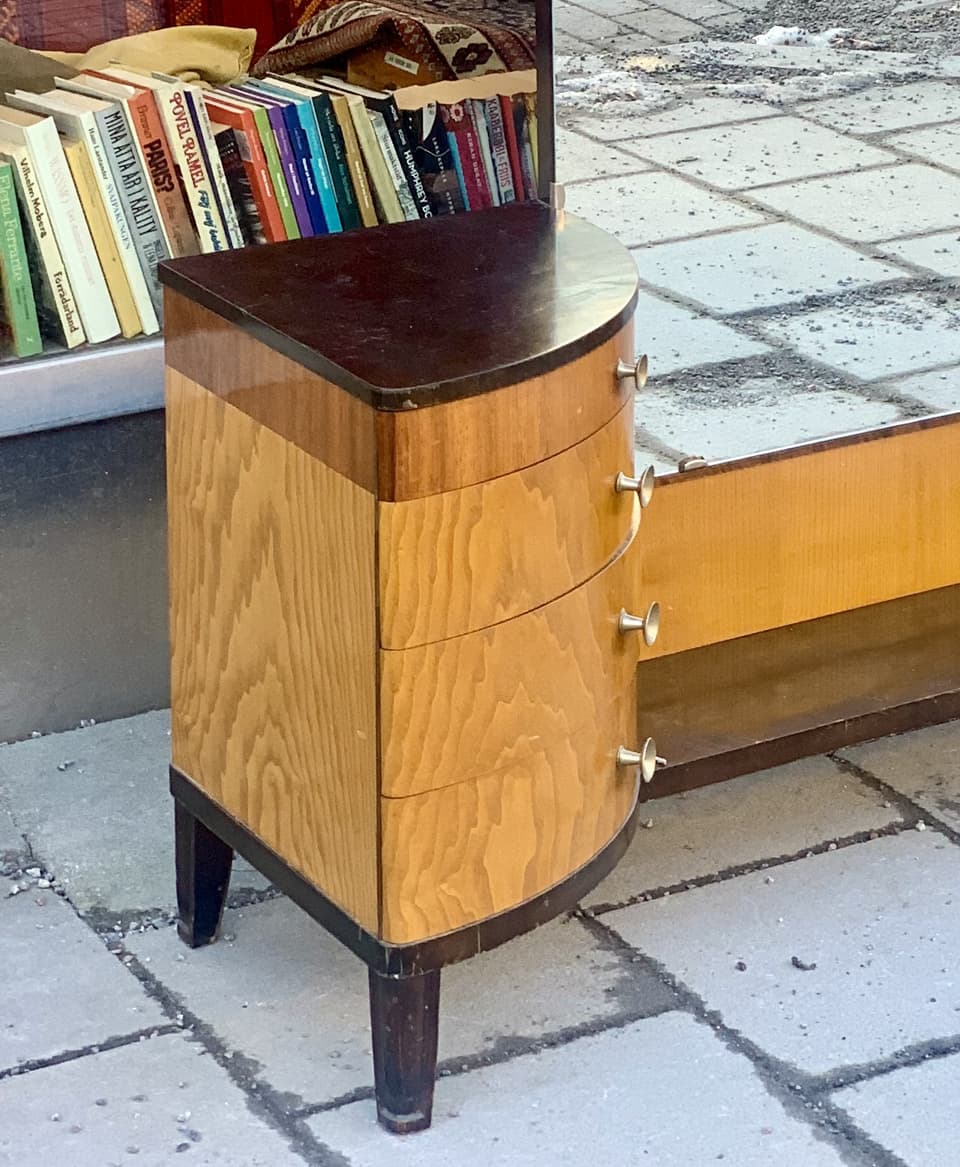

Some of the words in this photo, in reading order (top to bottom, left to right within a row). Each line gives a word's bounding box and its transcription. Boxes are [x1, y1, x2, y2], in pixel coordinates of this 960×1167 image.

[103, 110, 128, 144] MINA
[129, 196, 157, 236] KALITY
[142, 138, 175, 195] PARIS?
[167, 91, 192, 139] POVEL
[180, 136, 206, 188] RAMEL
[18, 157, 38, 198] Vilhelm
[29, 197, 50, 238] Moberg
[403, 149, 428, 204] HUMPHREY
[2, 217, 26, 281] Ferrante
